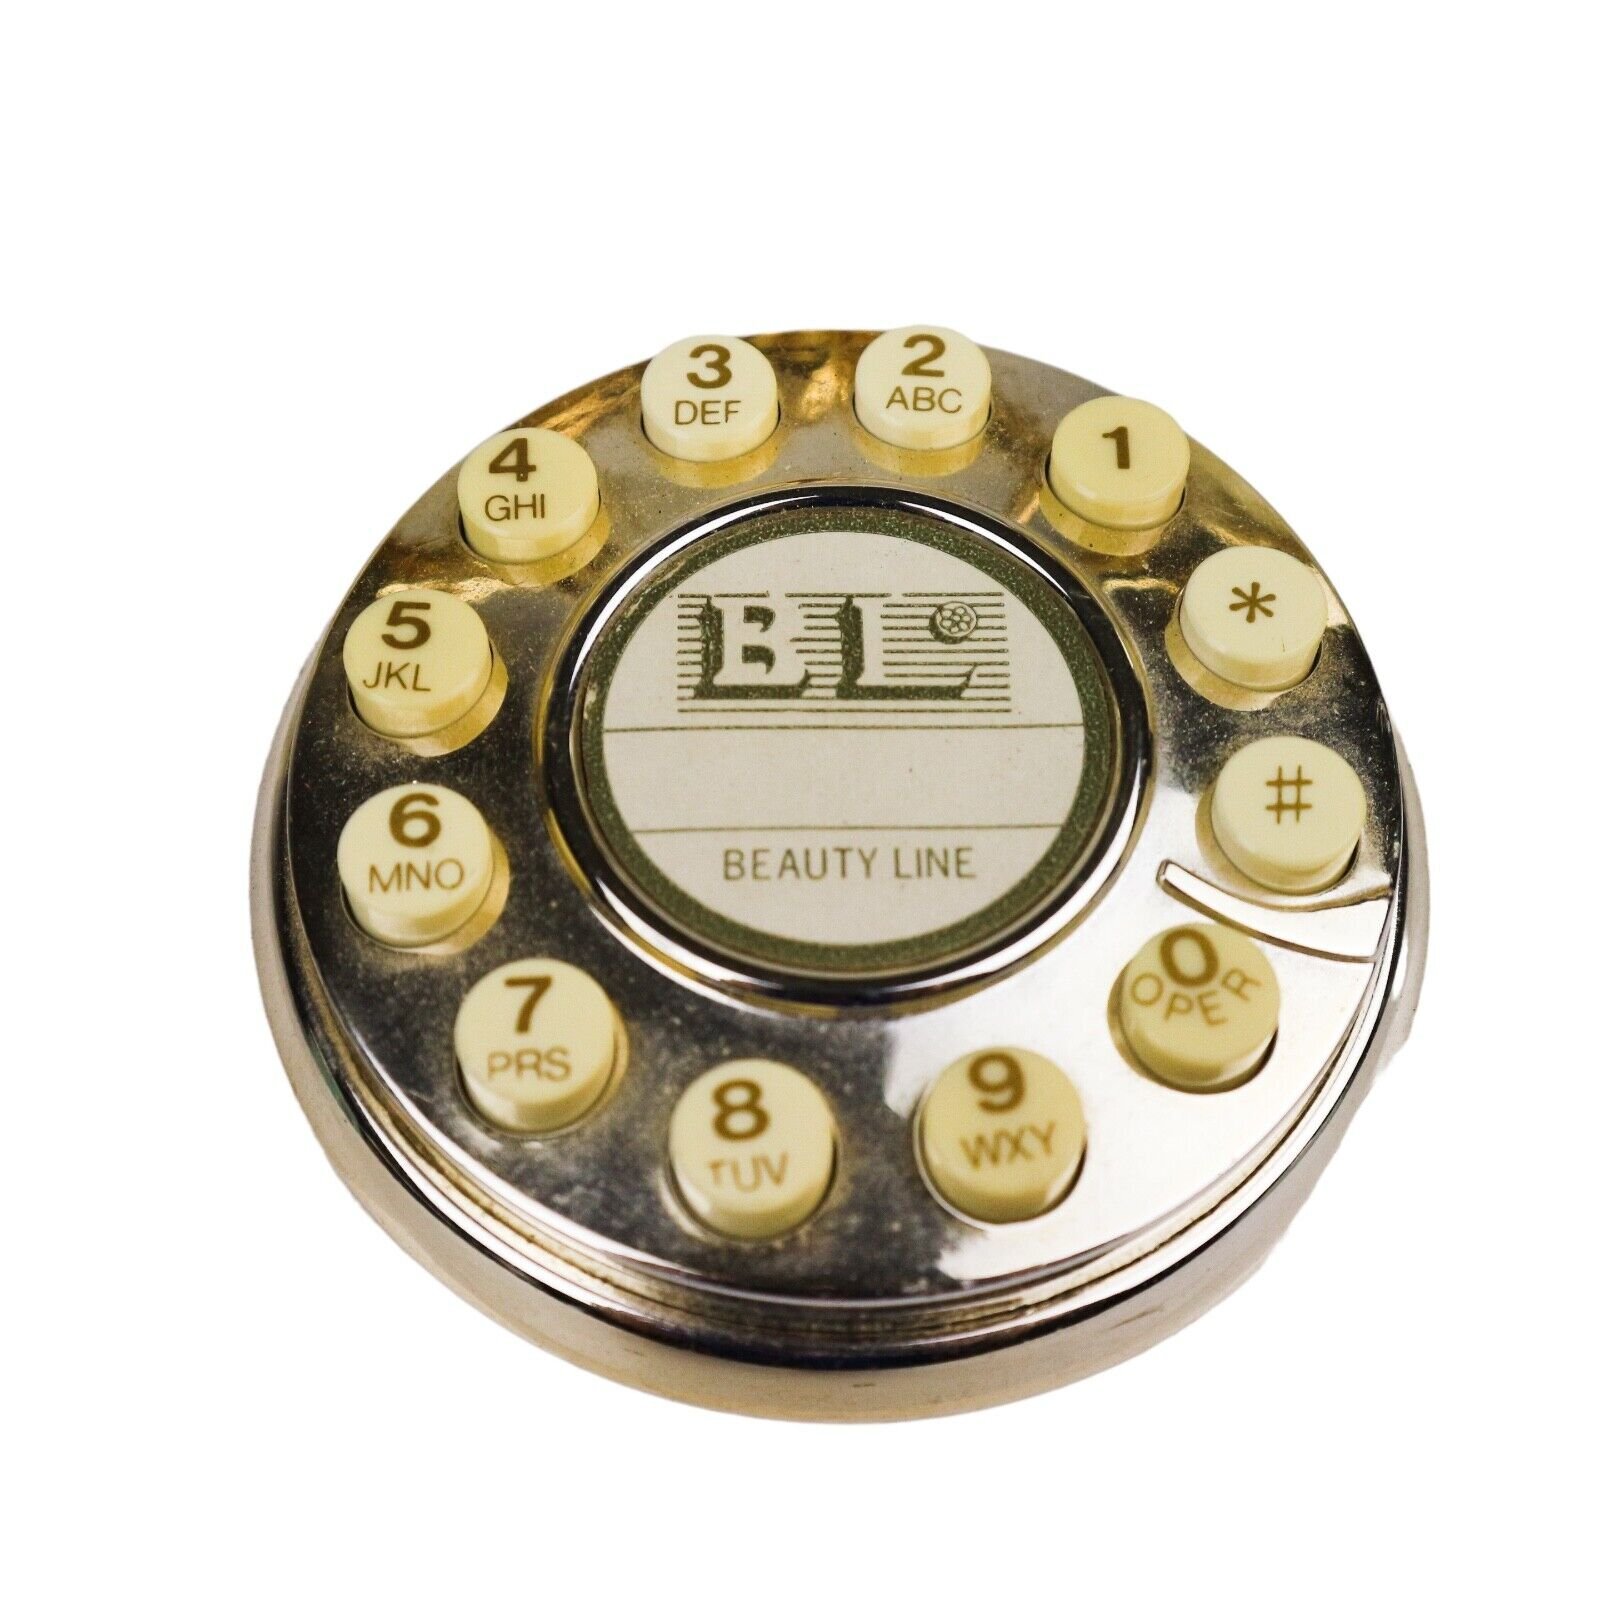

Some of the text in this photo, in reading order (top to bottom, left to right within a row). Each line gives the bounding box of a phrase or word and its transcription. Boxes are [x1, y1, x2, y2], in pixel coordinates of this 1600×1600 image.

[686, 344, 732, 389] 3
[901, 333, 946, 378] 2
[673, 399, 742, 426] DEF
[885, 386, 963, 414] ABC
[488, 437, 537, 483] 4
[1101, 426, 1131, 470] 1
[484, 492, 546, 522] GHI
[381, 601, 431, 650] 5
[692, 594, 978, 701] BL
[362, 661, 431, 692] JKL
[388, 792, 442, 848] 6
[368, 858, 465, 894] MNO
[722, 846, 977, 882] BEAUTY LINE
[1159, 928, 1219, 988] 0
[504, 975, 554, 1034] 7
[1130, 967, 1263, 1028] OPER
[487, 1046, 572, 1082] PRS
[966, 1051, 1027, 1114] 9
[711, 1079, 770, 1141] 8
[960, 1121, 1055, 1169] WXY
[707, 1152, 789, 1193] TUV
